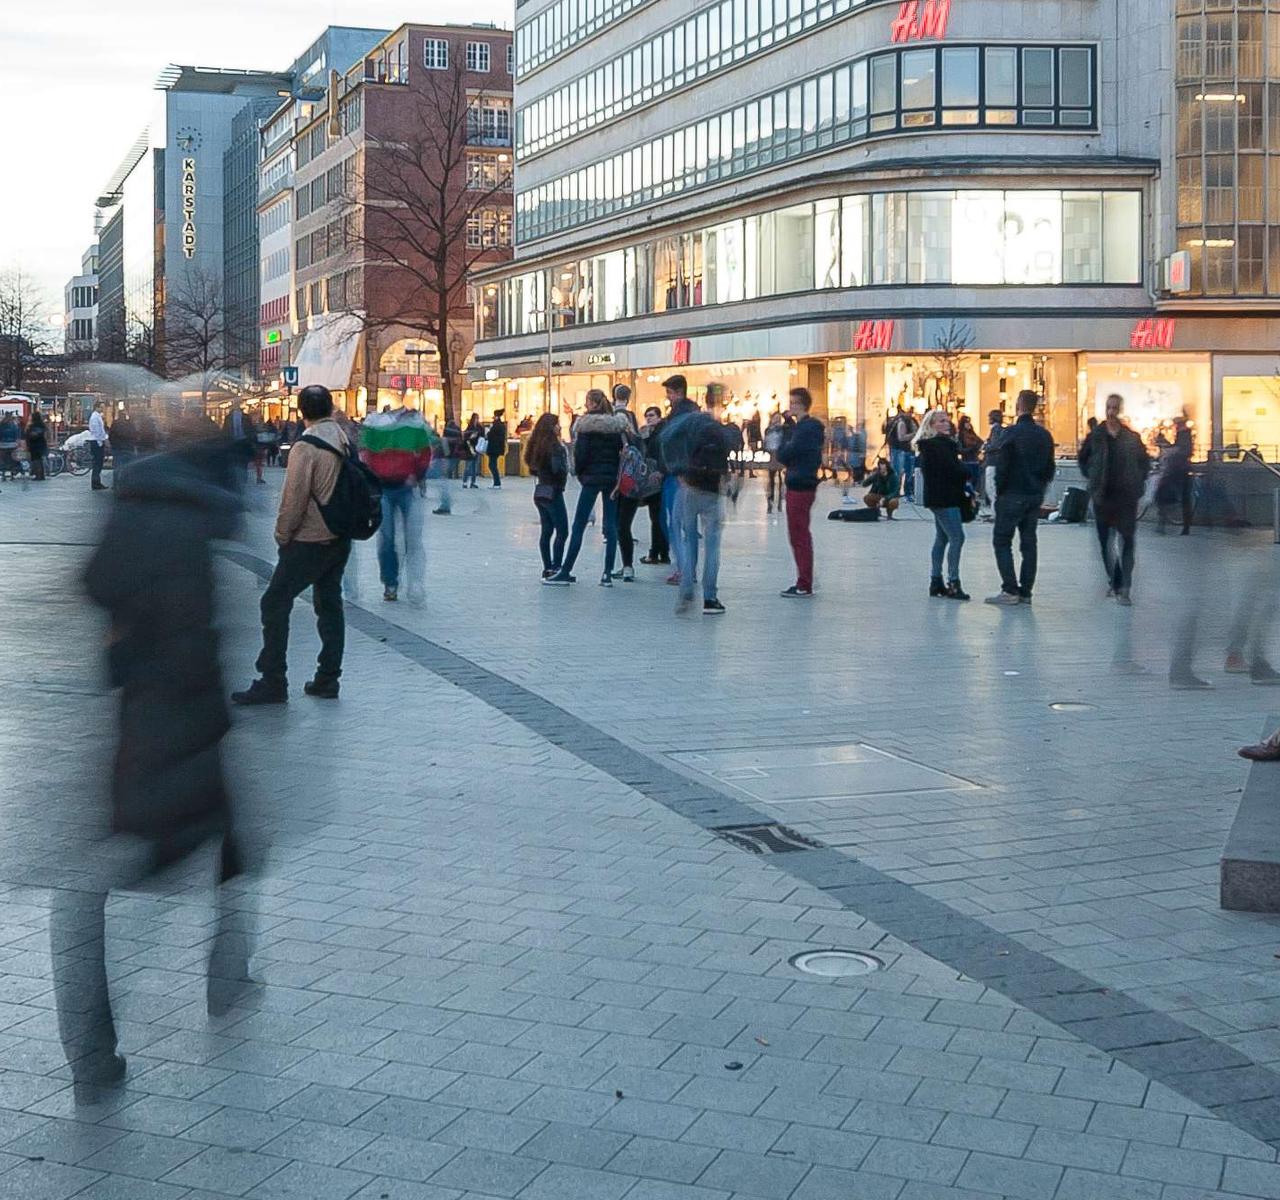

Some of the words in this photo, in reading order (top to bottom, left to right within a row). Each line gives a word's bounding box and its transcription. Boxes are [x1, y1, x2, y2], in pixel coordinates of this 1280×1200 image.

[183, 158, 195, 258] KARSTADT
[853, 319, 895, 351] H&M
[1130, 319, 1176, 351] H&M
[285, 369, 298, 384] U
